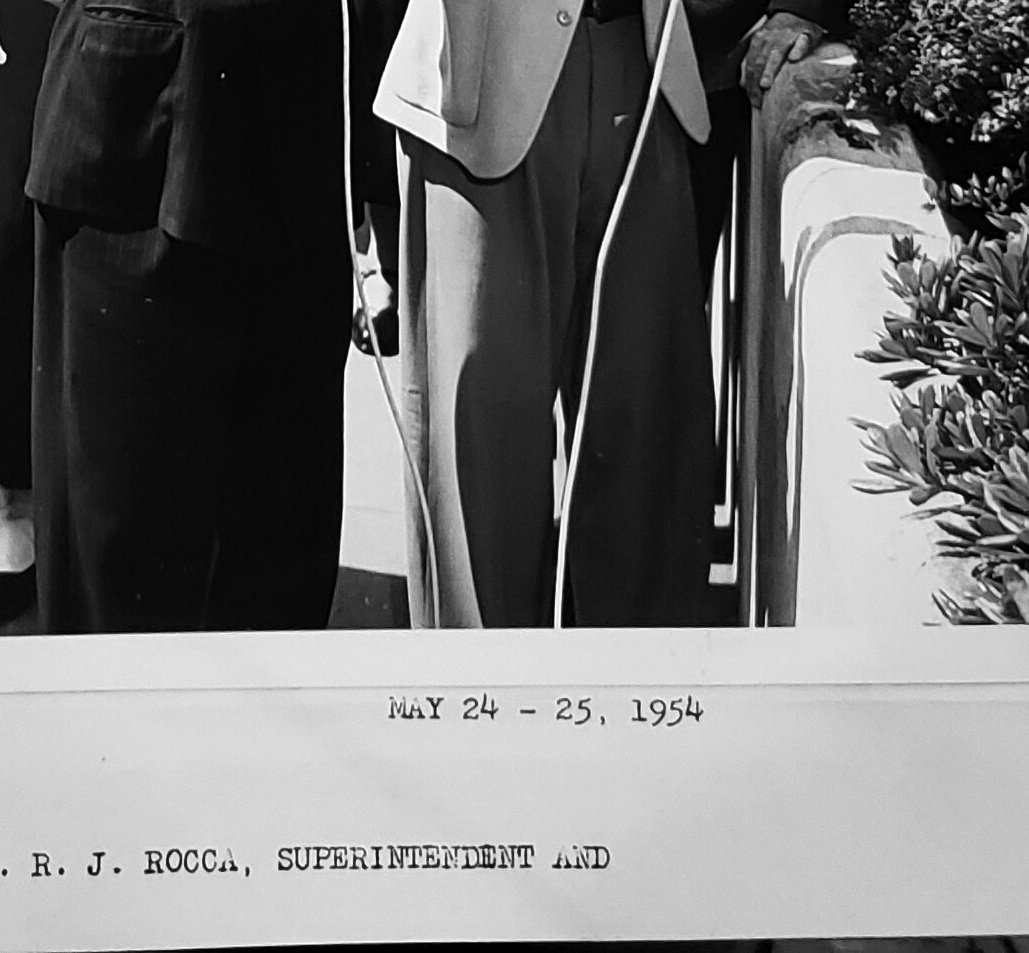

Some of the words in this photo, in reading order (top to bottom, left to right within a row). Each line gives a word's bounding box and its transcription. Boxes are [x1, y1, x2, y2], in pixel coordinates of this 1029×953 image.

[388, 696, 444, 719] MAY
[463, 693, 499, 720] 24
[556, 698, 605, 725] 25,
[632, 695, 704, 727] 1954
[31, 853, 65, 877] R.
[87, 852, 121, 876] J.
[144, 848, 250, 877] ROCCA,
[278, 844, 535, 871] SUPERINTENDENT
[552, 846, 610, 869] AND
